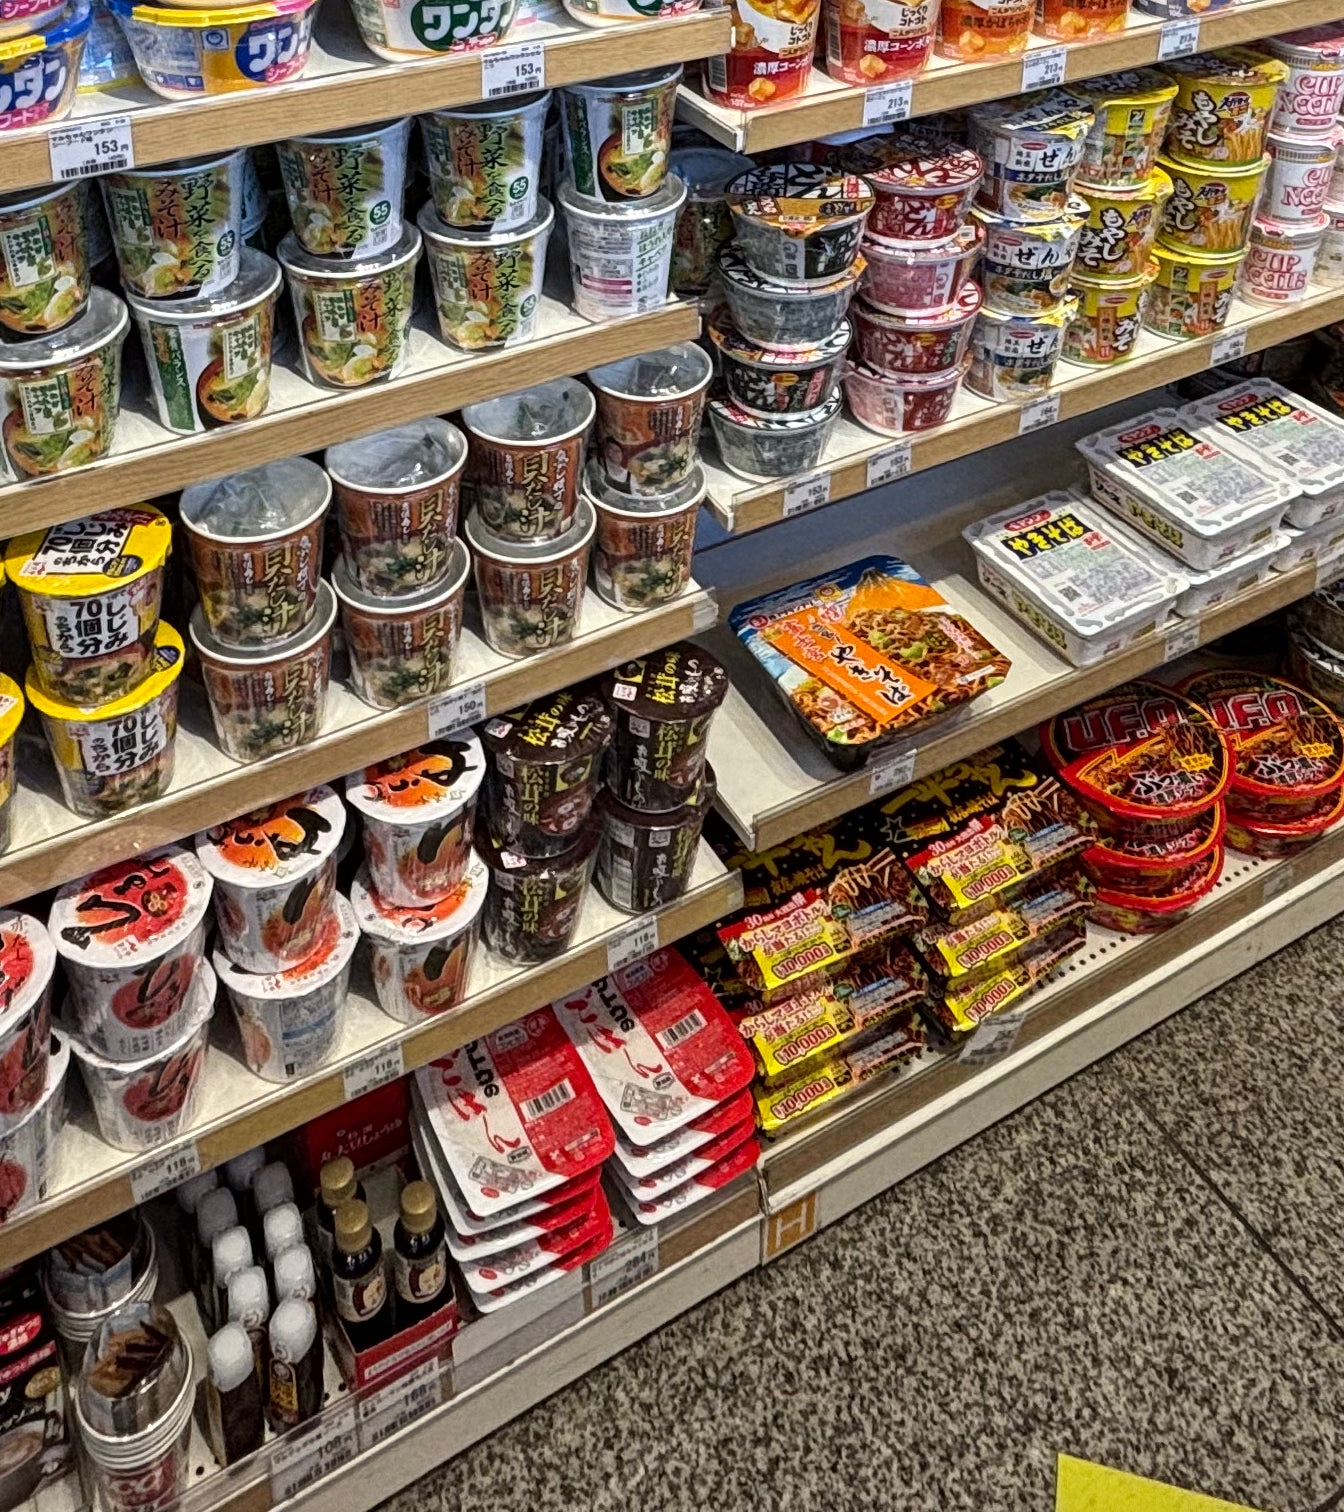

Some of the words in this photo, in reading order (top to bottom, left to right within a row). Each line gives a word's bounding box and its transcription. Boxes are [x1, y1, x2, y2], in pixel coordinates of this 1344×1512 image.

[454, 122, 475, 177] みそ汁
[156, 177, 183, 238] みそ汁
[372, 205, 390, 220] 55
[512, 181, 528, 196] 55
[1228, 398, 1294, 429] やきそば
[1127, 430, 1196, 465] やきそば
[518, 450, 548, 542] 貝だし汁
[414, 489, 442, 586] 貝だし汁
[1010, 515, 1087, 554] やきそば
[263, 551, 295, 642] 貝だし汁
[830, 644, 915, 707] やきそば
[656, 721, 679, 783] 松茸の味
[522, 765, 543, 827] 松茸の味
